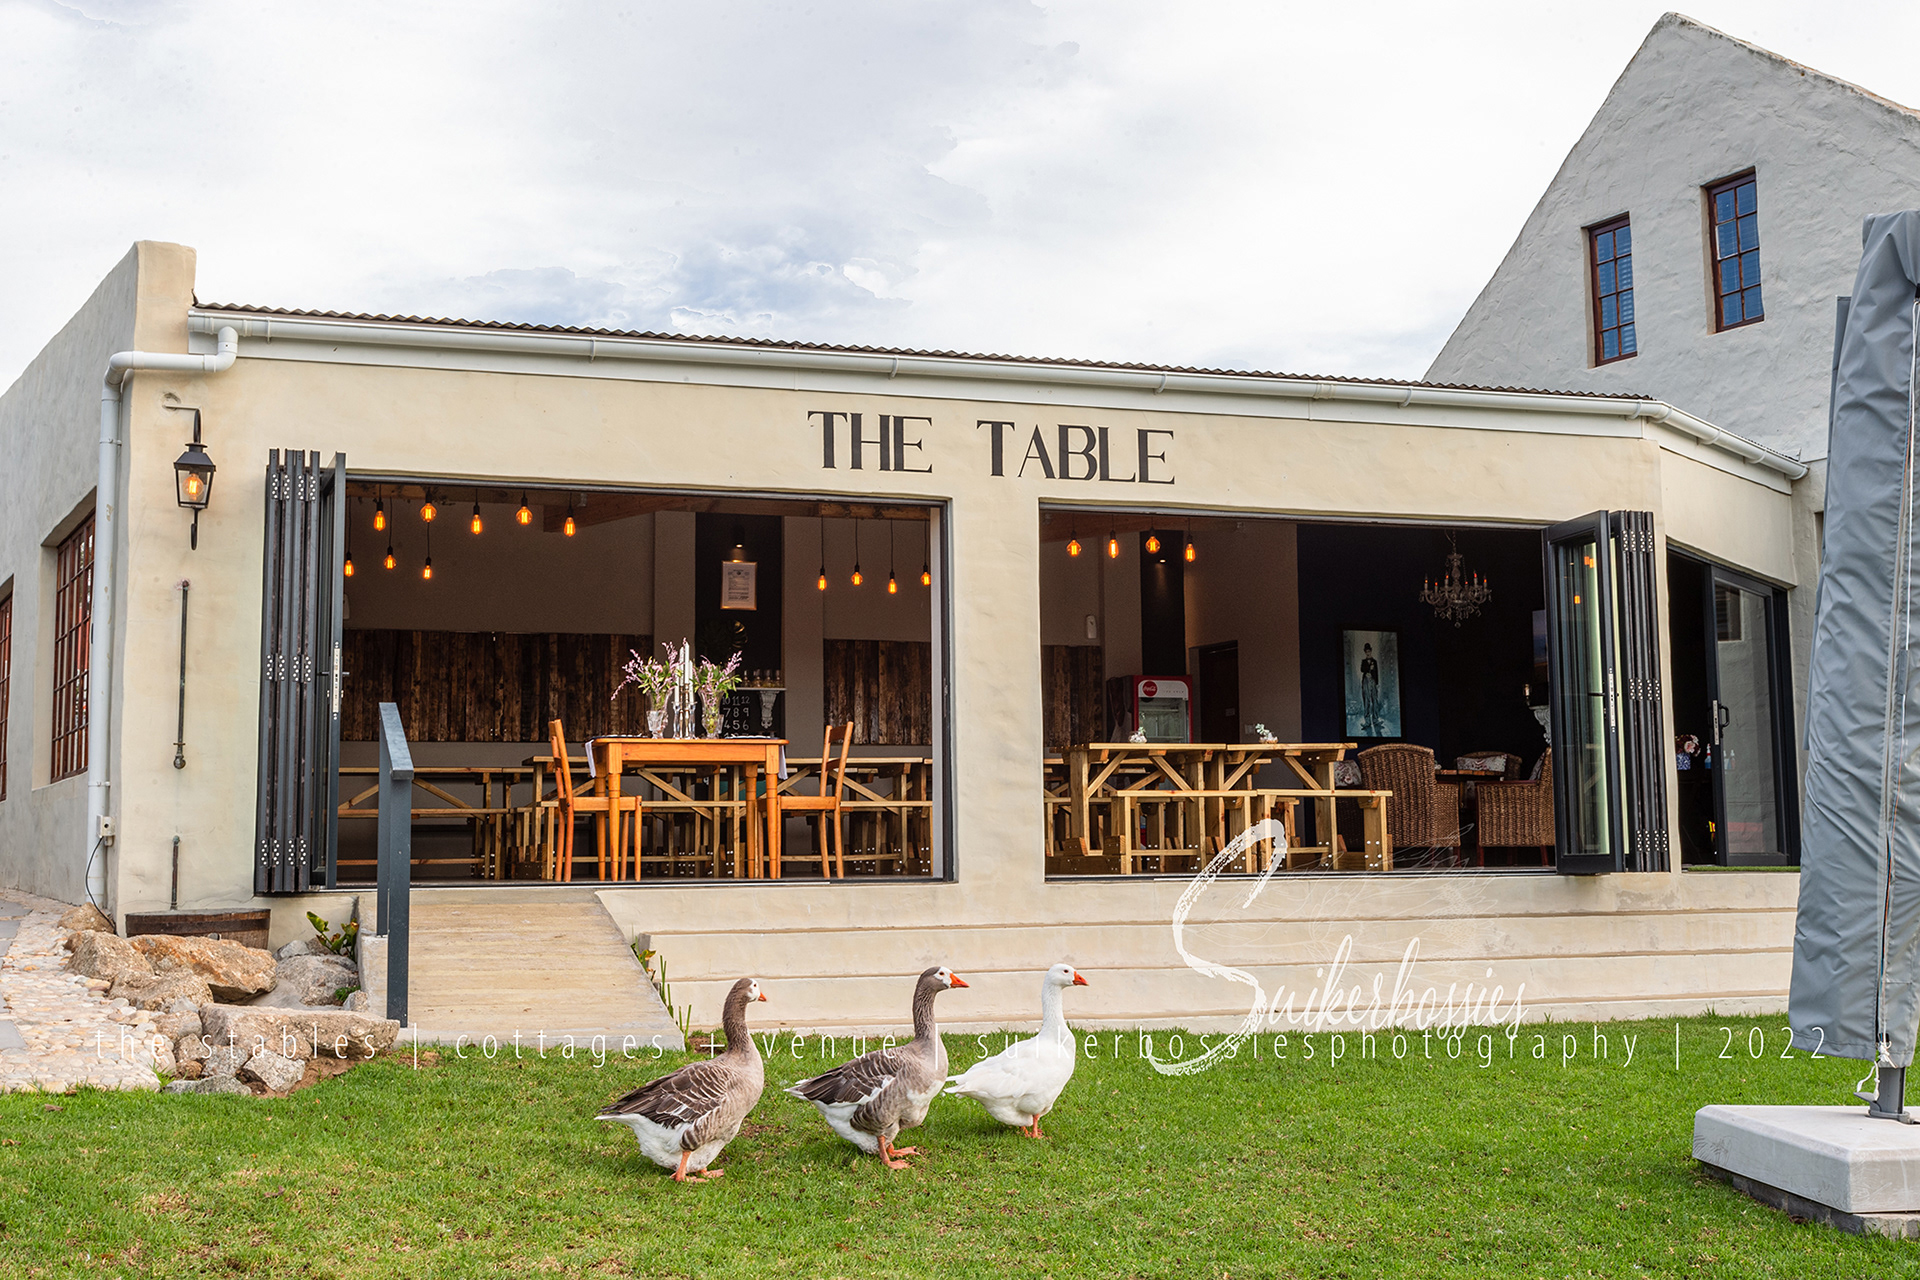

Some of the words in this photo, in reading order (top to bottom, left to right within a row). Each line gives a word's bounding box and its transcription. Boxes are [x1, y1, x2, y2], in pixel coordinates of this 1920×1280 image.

[807, 410, 933, 474] THE
[976, 419, 1175, 485] TABLE
[723, 707, 731, 718] 7
[733, 707, 740, 718] 8
[742, 707, 749, 717] 9
[724, 719, 731, 729] 4
[732, 719, 741, 730] 5
[742, 719, 749, 731] 6
